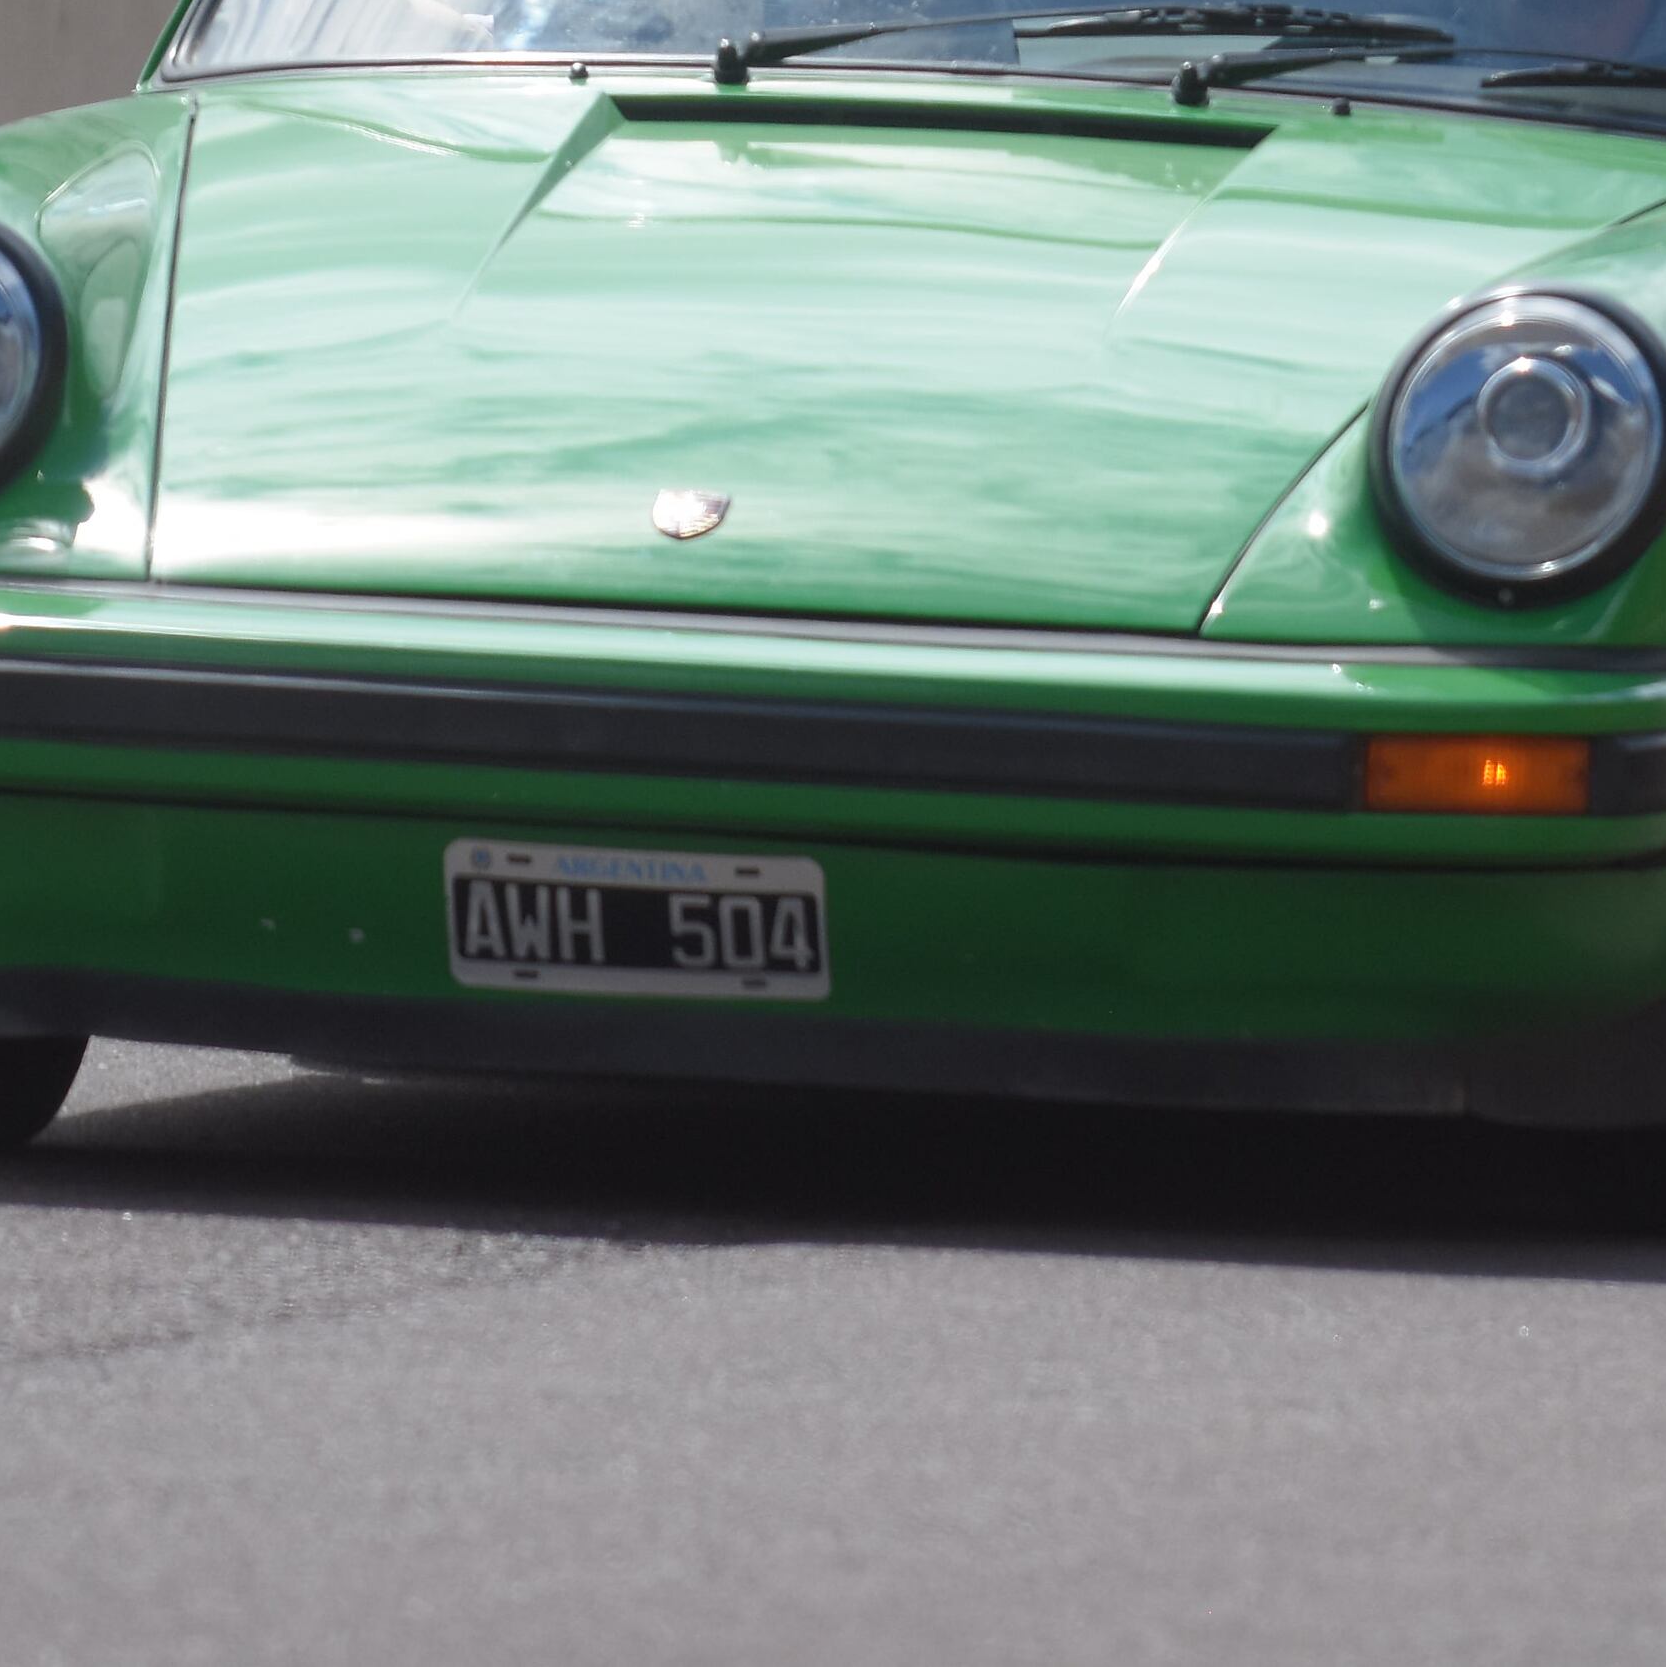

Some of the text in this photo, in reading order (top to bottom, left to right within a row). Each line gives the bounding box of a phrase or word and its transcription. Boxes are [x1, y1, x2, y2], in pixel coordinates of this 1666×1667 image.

[555, 856, 705, 882] ARGENTINA
[464, 879, 815, 969] AWH 504
